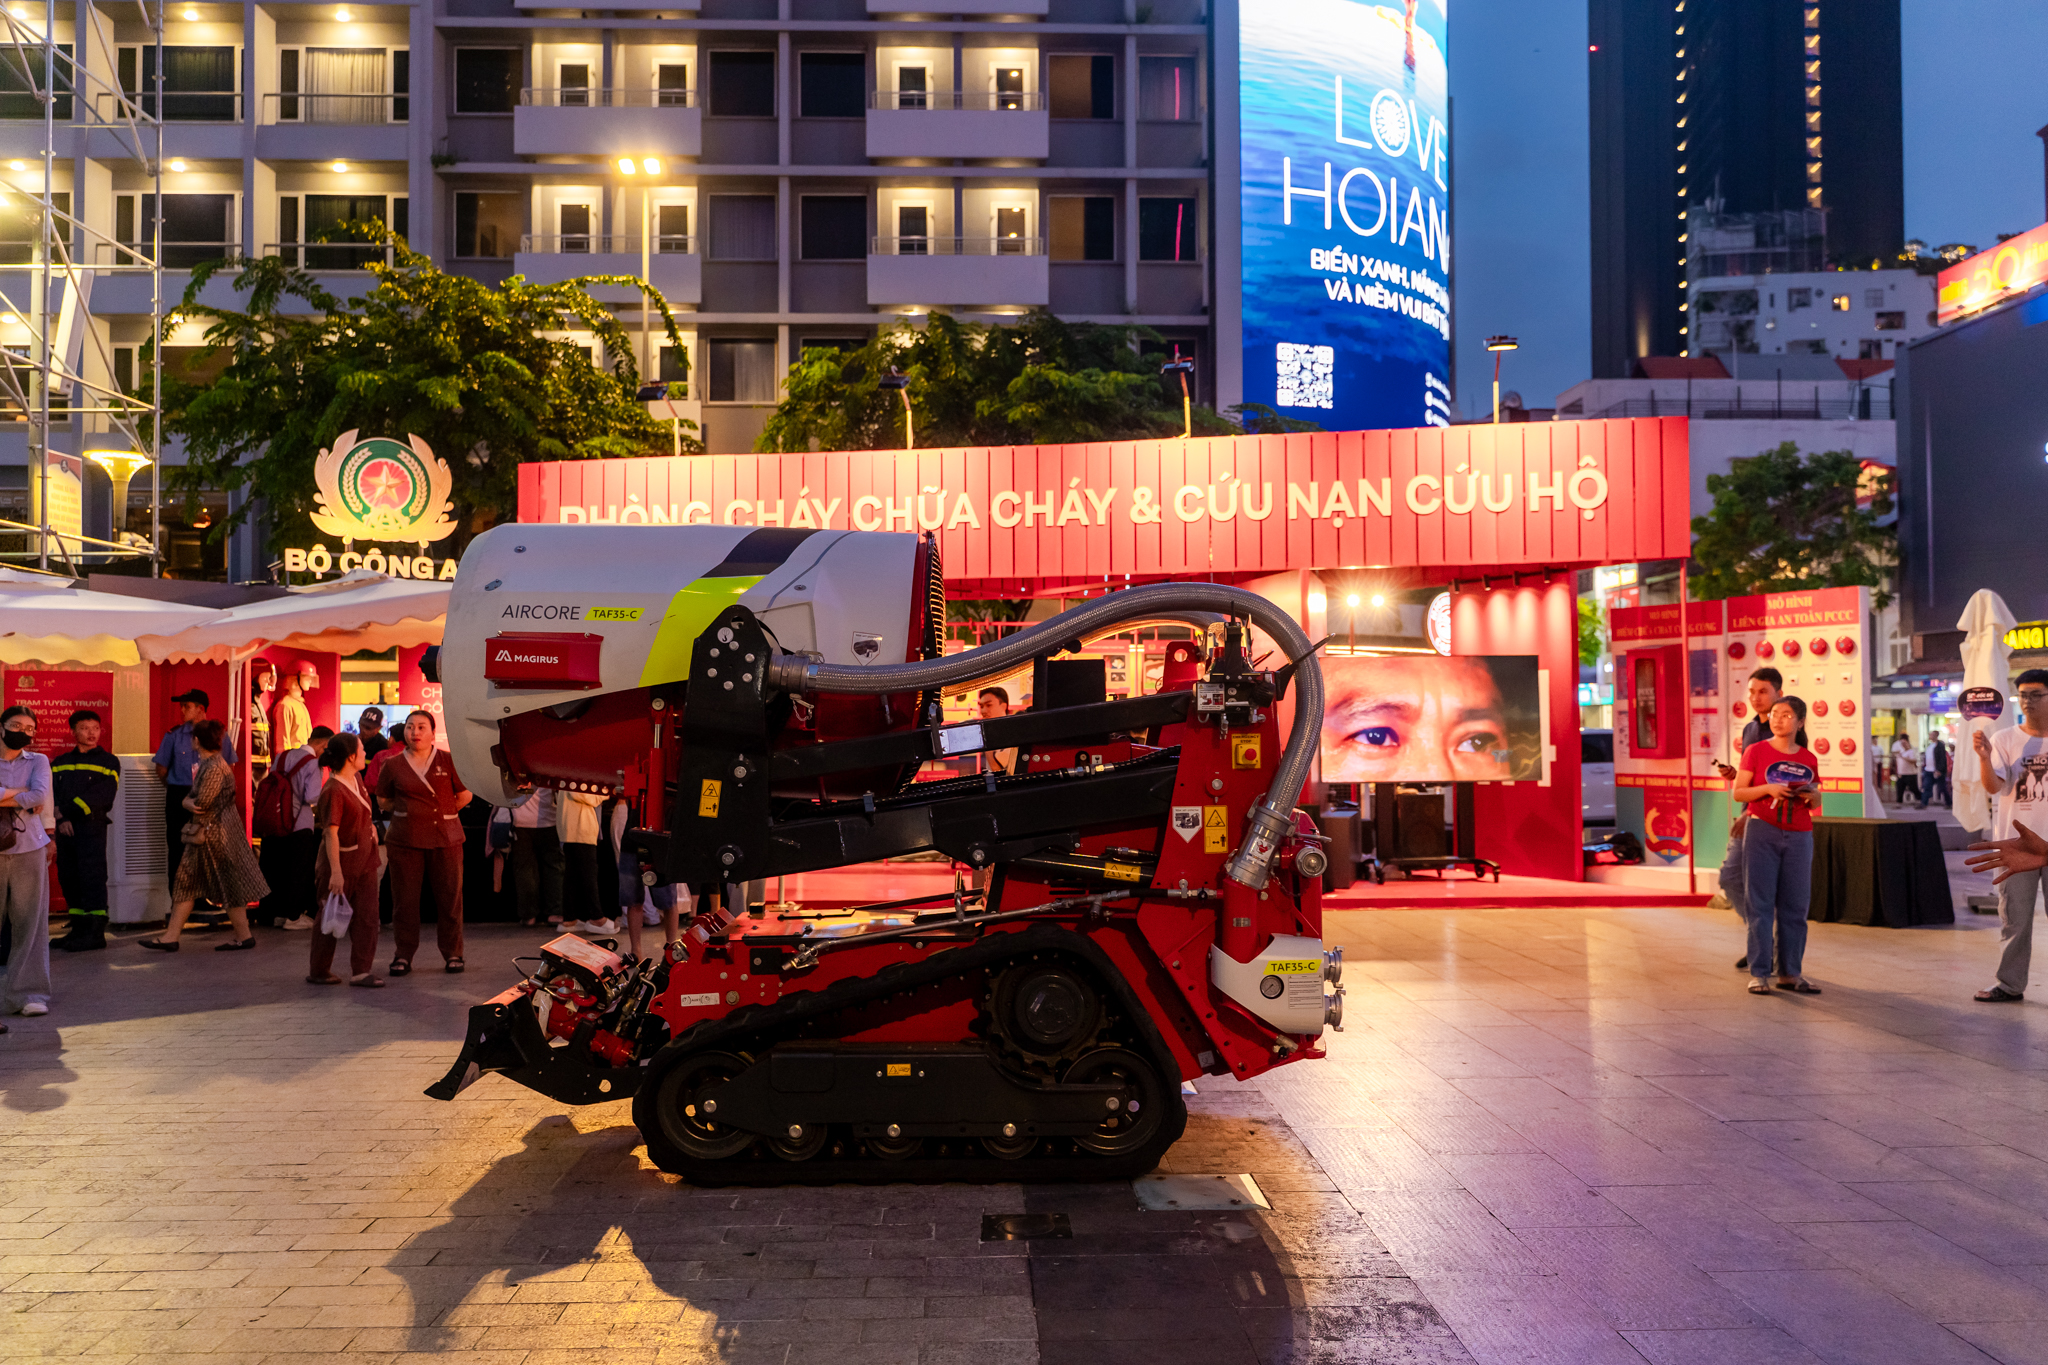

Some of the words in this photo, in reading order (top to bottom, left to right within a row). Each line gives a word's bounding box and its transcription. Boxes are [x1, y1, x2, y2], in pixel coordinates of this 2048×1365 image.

[1335, 75, 1448, 192] LOVE
[1360, 255, 1411, 290] XANH,
[1324, 276, 1353, 303] VÀ
[1399, 293, 1422, 320] VUI
[724, 486, 842, 530] CHÁY
[852, 485, 980, 531] CHỮA
[990, 476, 1118, 528] CHÁY
[1130, 486, 1162, 524] &
[1174, 471, 1273, 523] CỨU
[1288, 477, 1392, 528] NẠN
[1406, 462, 1513, 516] CỨU
[1529, 455, 1608, 521] HỘ
[285, 543, 332, 579] BỘ
[339, 547, 434, 579] CÔNG
[1767, 596, 1785, 610] MÔ
[1786, 595, 1812, 608] HÌNH
[502, 604, 580, 620] AIRCORE
[593, 609, 637, 619] TAF35-C
[1757, 616, 1776, 626] GIA
[1777, 614, 1792, 625] AN
[1793, 610, 1822, 624] TOÀN
[1824, 609, 1854, 622] PCCC
[514, 654, 559, 664] MAGIRUS
[43, 698, 72, 707] TUYÊN
[74, 698, 109, 707] TRUYỀN
[365, 711, 377, 721] 114
[1271, 962, 1315, 971] TAF35-C
